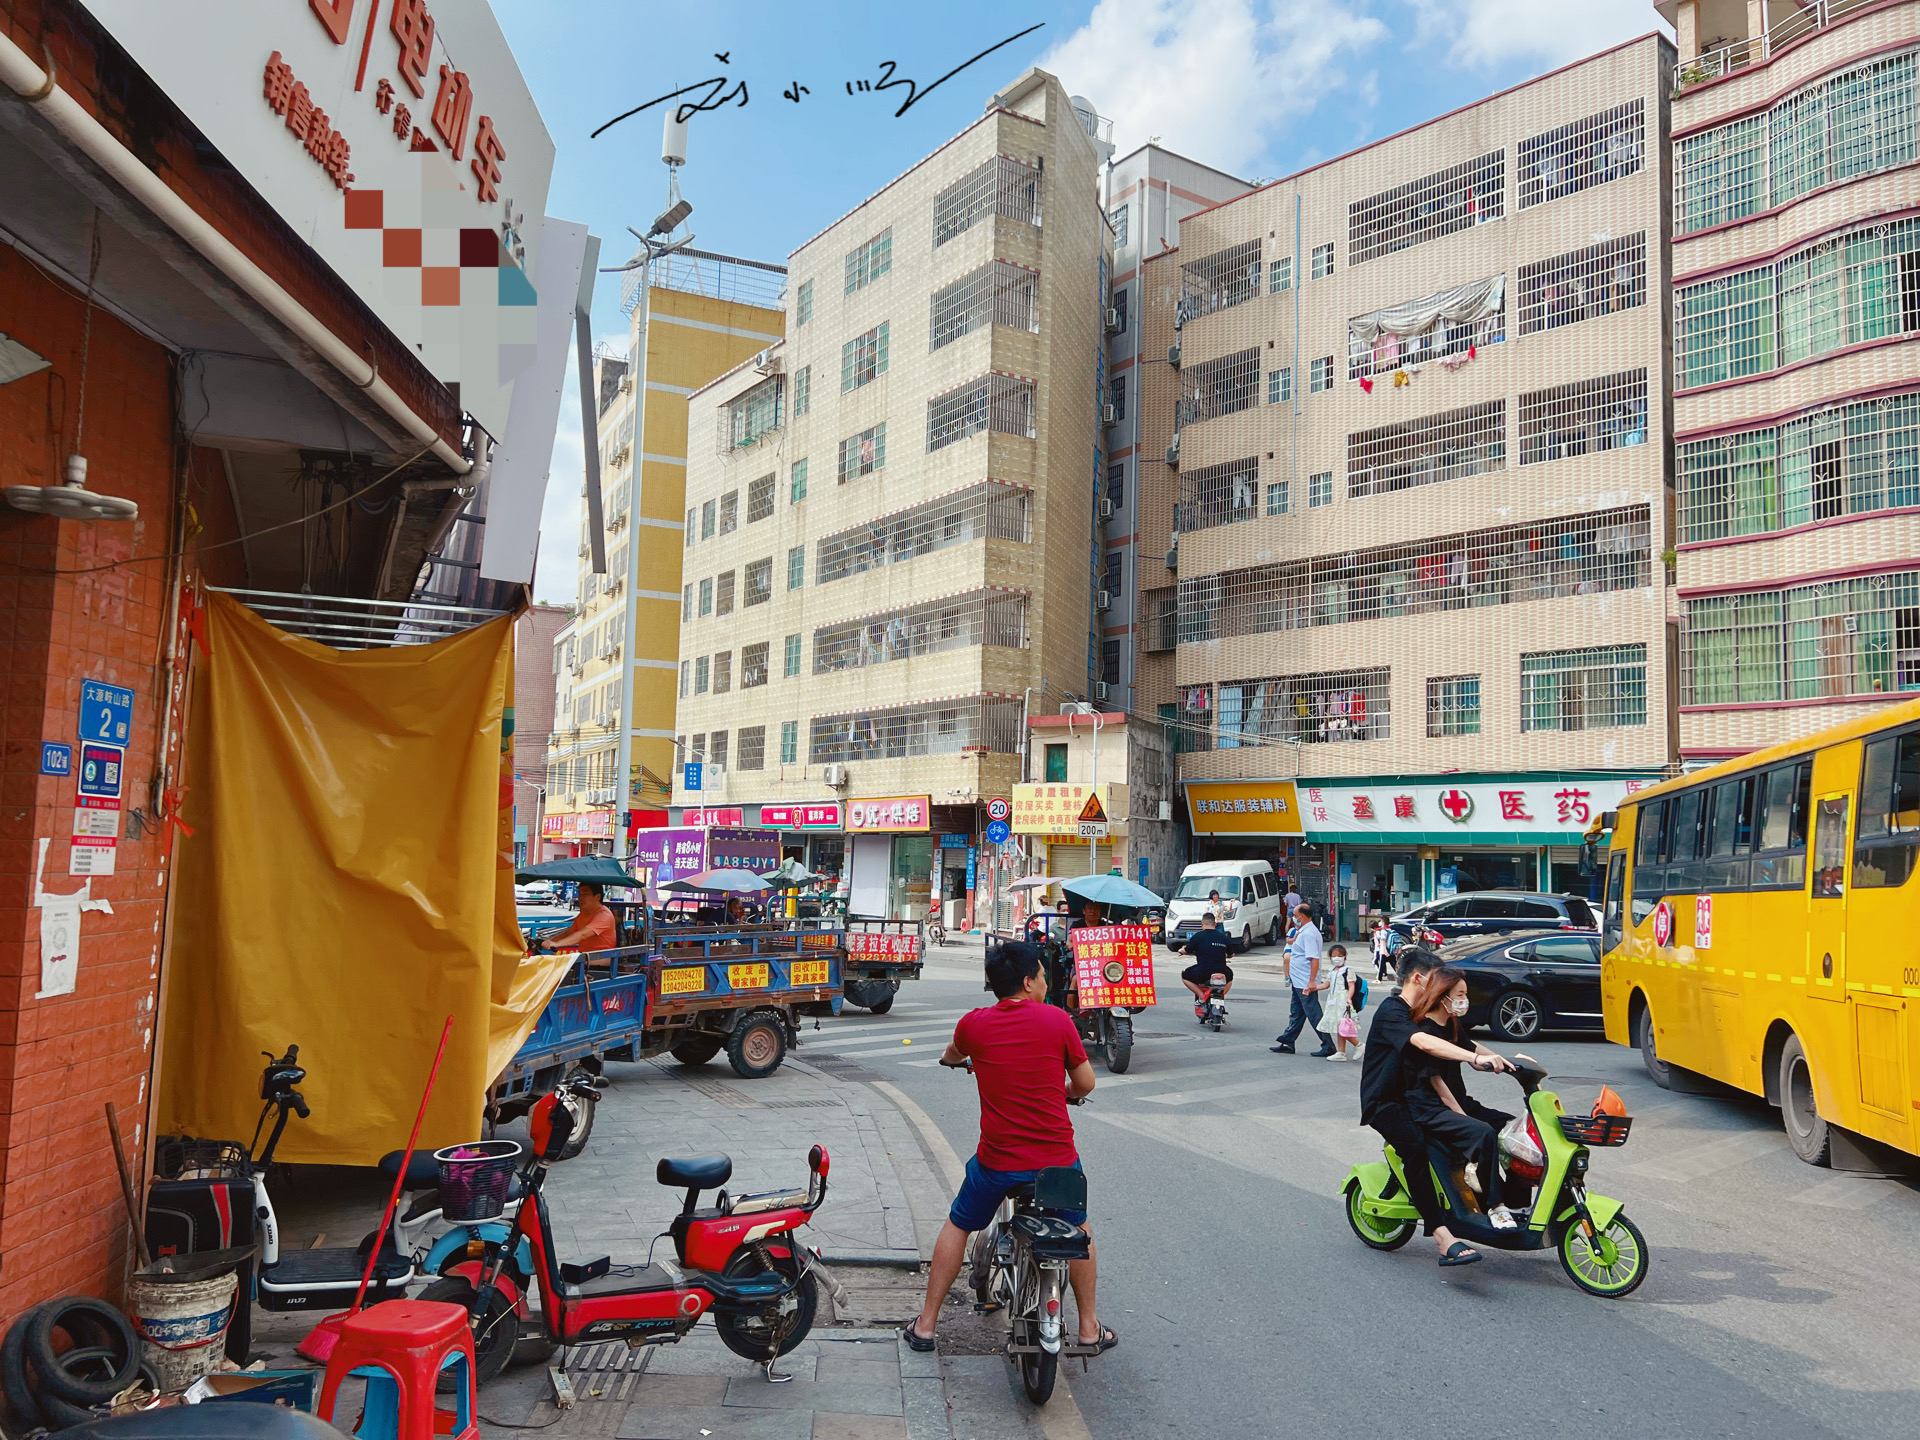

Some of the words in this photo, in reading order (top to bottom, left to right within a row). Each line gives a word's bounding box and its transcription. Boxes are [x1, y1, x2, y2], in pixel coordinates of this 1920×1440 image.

[390, 0, 506, 203] 电动车
[99, 708, 112, 738] 2
[46, 750, 62, 768] 102
[1034, 787, 1082, 798] 房屋租售
[992, 804, 1004, 814] 20
[1015, 800, 1054, 811] 房屋买卖
[1196, 797, 1288, 814] 联和达服装辅料
[1309, 788, 1328, 822] 医保
[1499, 788, 1590, 823] 医药
[1014, 814, 1045, 825] 套房装修
[1081, 825, 1103, 835] 200m
[674, 857, 700, 869] 当天送达
[1657, 911, 1667, 938] 停
[1074, 927, 1149, 942] 13825117141
[869, 935, 888, 953] 拉货
[1077, 942, 1148, 959] 搬家搬厂拉货
[793, 961, 826, 973] 回收门窗
[1078, 960, 1100, 969] 高价
[663, 969, 702, 981] 18520064270
[793, 972, 827, 983] 家具家电
[1080, 969, 1101, 978] 回收
[663, 980, 702, 993] 13042049220
[731, 976, 768, 988] 搬家搬厂
[1080, 978, 1102, 988] 废品
